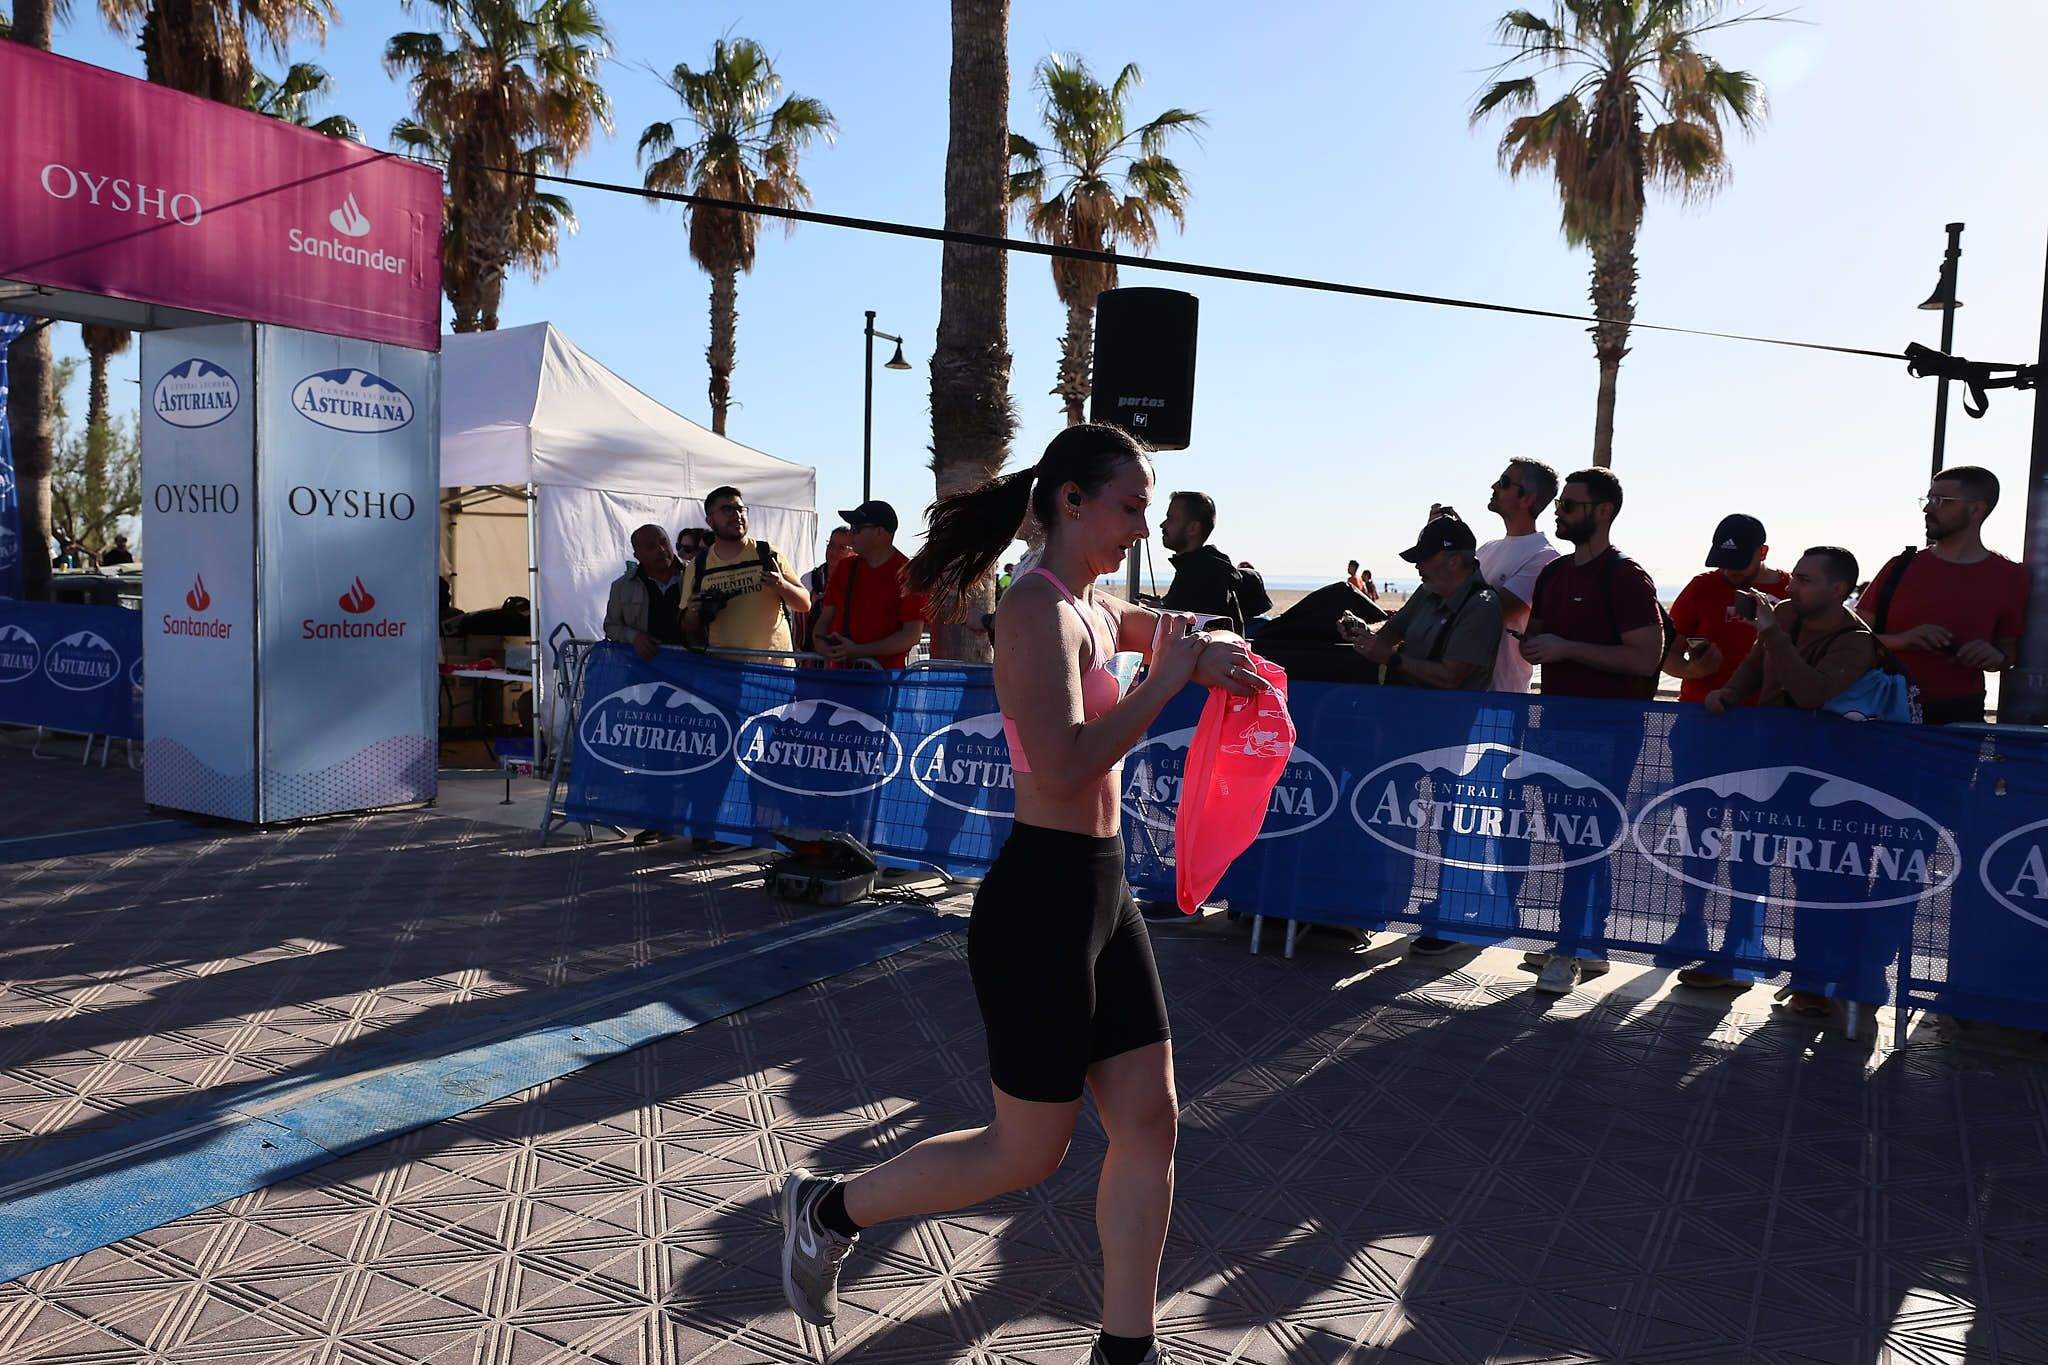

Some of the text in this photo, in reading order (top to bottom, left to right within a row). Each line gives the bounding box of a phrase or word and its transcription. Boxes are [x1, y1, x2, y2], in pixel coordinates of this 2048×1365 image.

[40, 164, 202, 226] OYSHO
[288, 229, 407, 275] Santander
[159, 387, 232, 412] ASTURIANA
[302, 386, 406, 422] ASTURIANA
[154, 483, 239, 513] OYSHO
[288, 486, 415, 521] OYSHO
[163, 615, 232, 639] Santander
[303, 618, 406, 640] Santander
[49, 651, 110, 678] ASTURIANA
[589, 710, 718, 757] ASTURIANA
[743, 726, 887, 776] ASTURIANA
[957, 744, 1007, 756] CENTRA
[922, 743, 1014, 788] ASTUR
[1368, 780, 1604, 847] ASTURIANA
[1706, 807, 1924, 842] CENTRAL LECHERA
[1654, 805, 1932, 883] ASTURIANA
